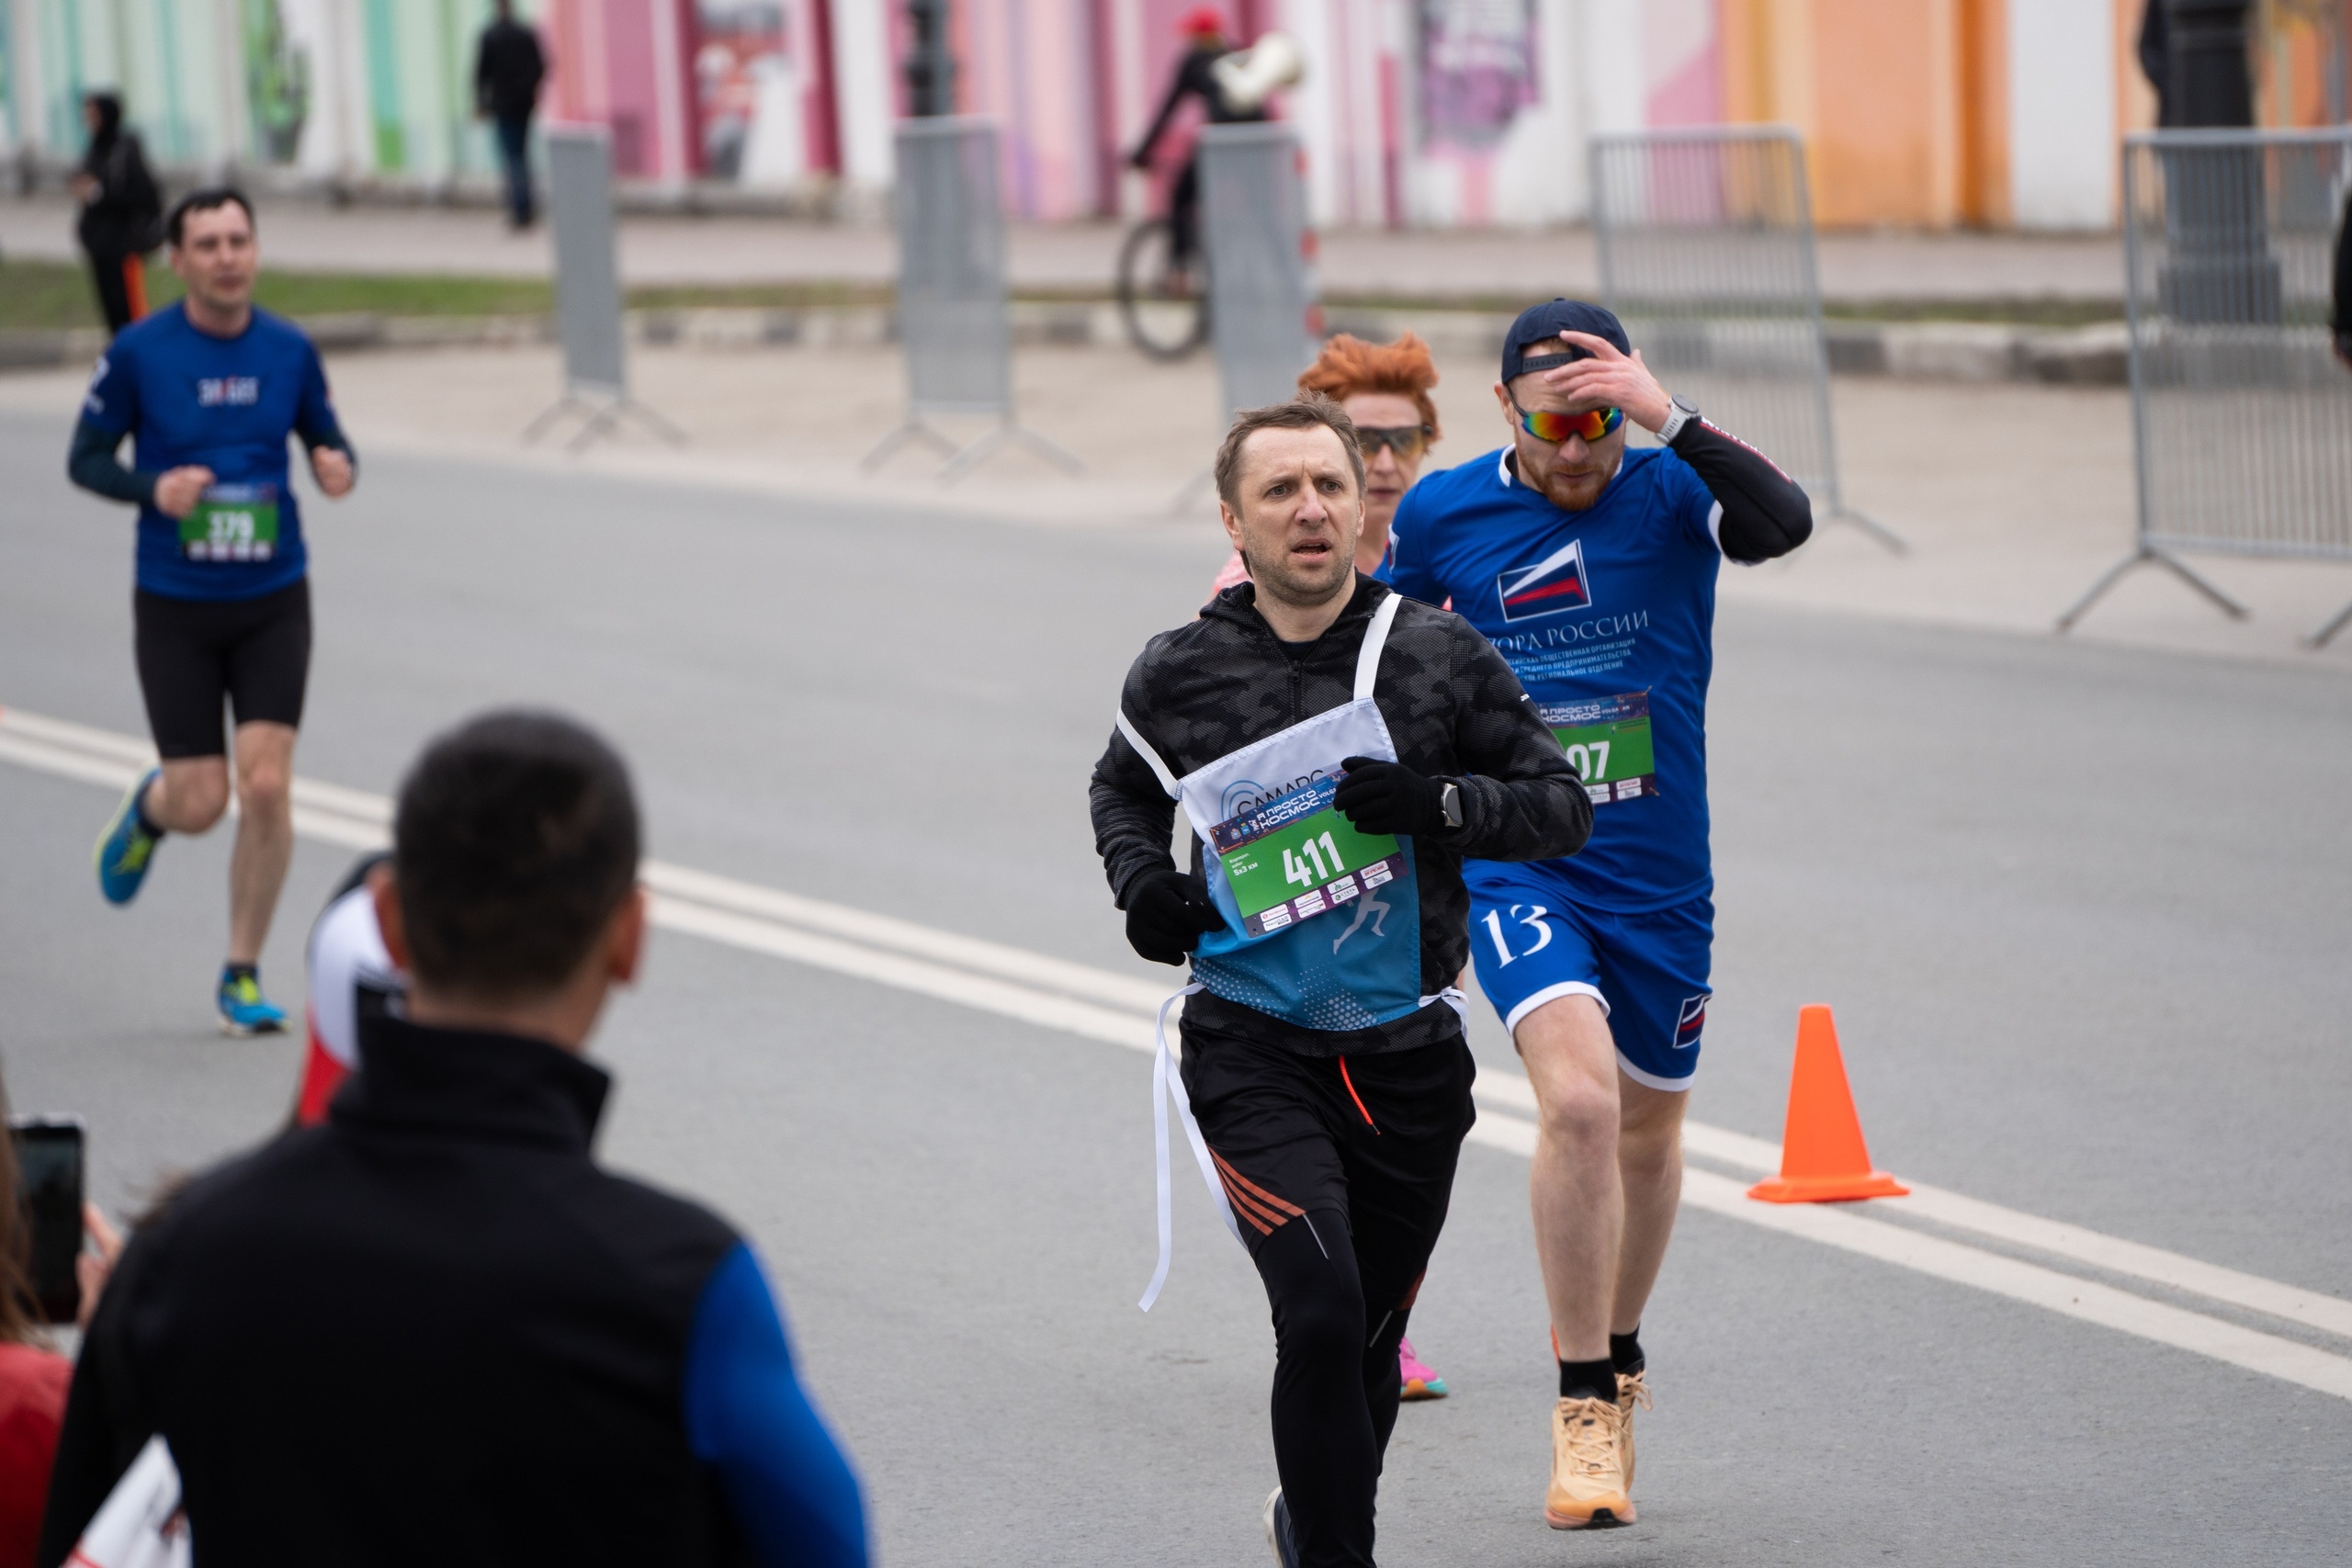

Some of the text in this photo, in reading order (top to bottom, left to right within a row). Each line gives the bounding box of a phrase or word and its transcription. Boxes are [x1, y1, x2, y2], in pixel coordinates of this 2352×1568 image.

[1546, 609, 1649, 647] РОССИИ
[1520, 663, 1553, 673] СРЕДНЕГО
[1553, 649, 1632, 670] ПРЕДПРИНИМАТЕЛЬСТВА
[1539, 647, 1590, 662] ОБЩЕСТВЕННАЯ
[1590, 637, 1636, 653] ОРГАНИЗАЦИЯ
[1588, 660, 1624, 674] ОТДЕЛЕНИЕ
[1549, 704, 1600, 714] ПРОСТО
[1256, 789, 1317, 821] Я ПРОСТО
[1259, 796, 1320, 829] КОСМОС
[1283, 830, 1345, 887] 411
[1481, 904, 1553, 969] 13
